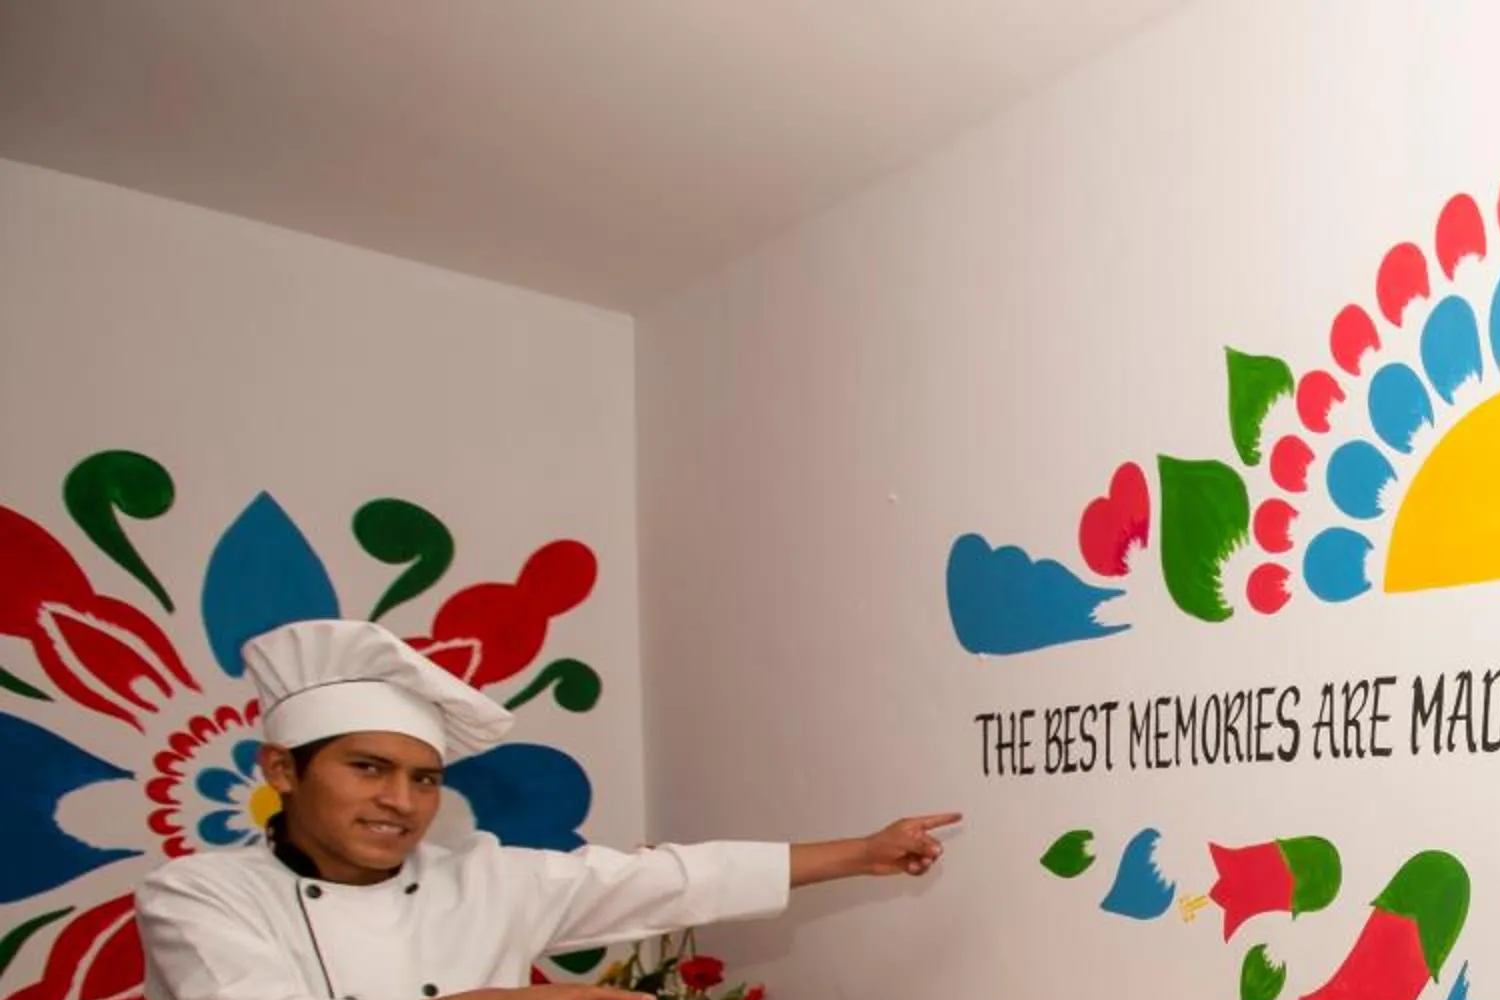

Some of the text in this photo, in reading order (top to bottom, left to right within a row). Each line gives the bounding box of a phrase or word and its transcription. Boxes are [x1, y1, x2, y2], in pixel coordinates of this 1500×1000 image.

[974, 709, 1036, 777] THE
[1043, 701, 1119, 775] BEST
[1128, 685, 1301, 770] MEMORIES
[1312, 676, 1397, 760] ARE
